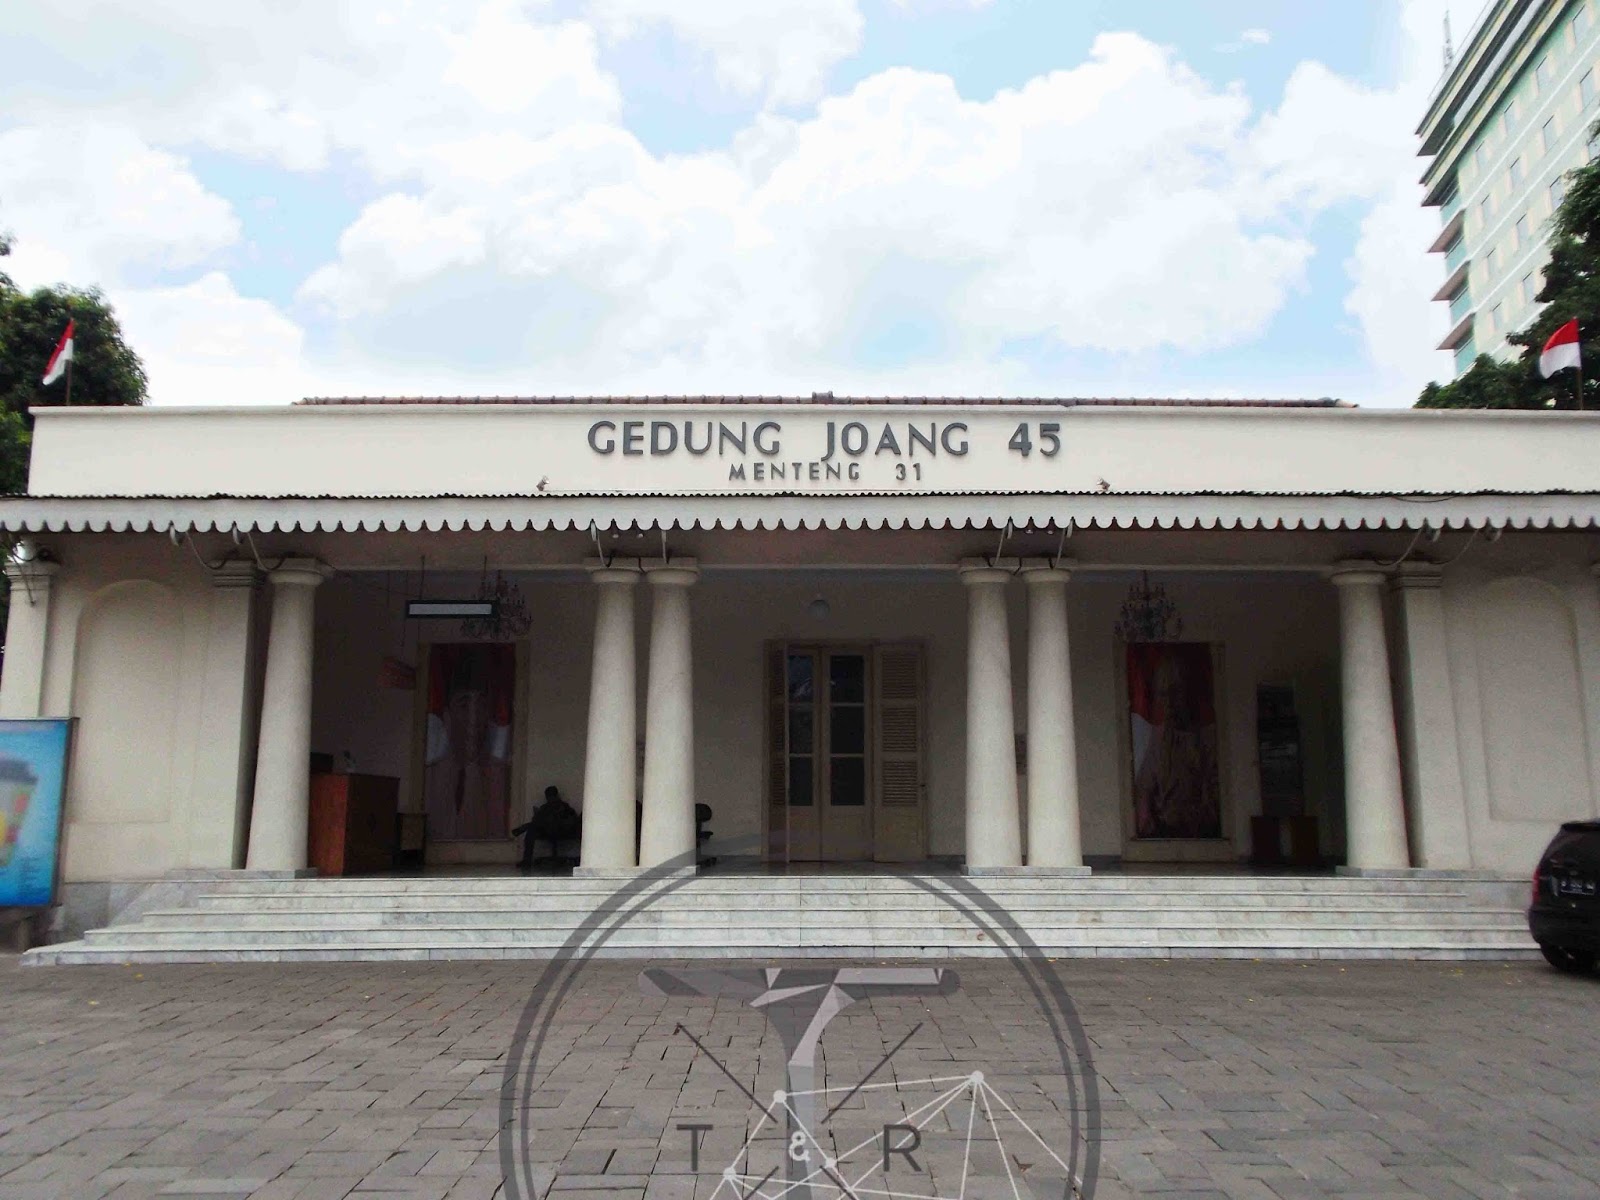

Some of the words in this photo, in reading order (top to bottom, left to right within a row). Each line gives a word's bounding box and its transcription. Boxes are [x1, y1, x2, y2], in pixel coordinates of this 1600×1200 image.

[587, 420, 781, 456] GEDUNG
[820, 421, 969, 462] JOANG
[1008, 422, 1061, 457] 45
[728, 462, 860, 481] MENTENG
[895, 462, 922, 481] 31
